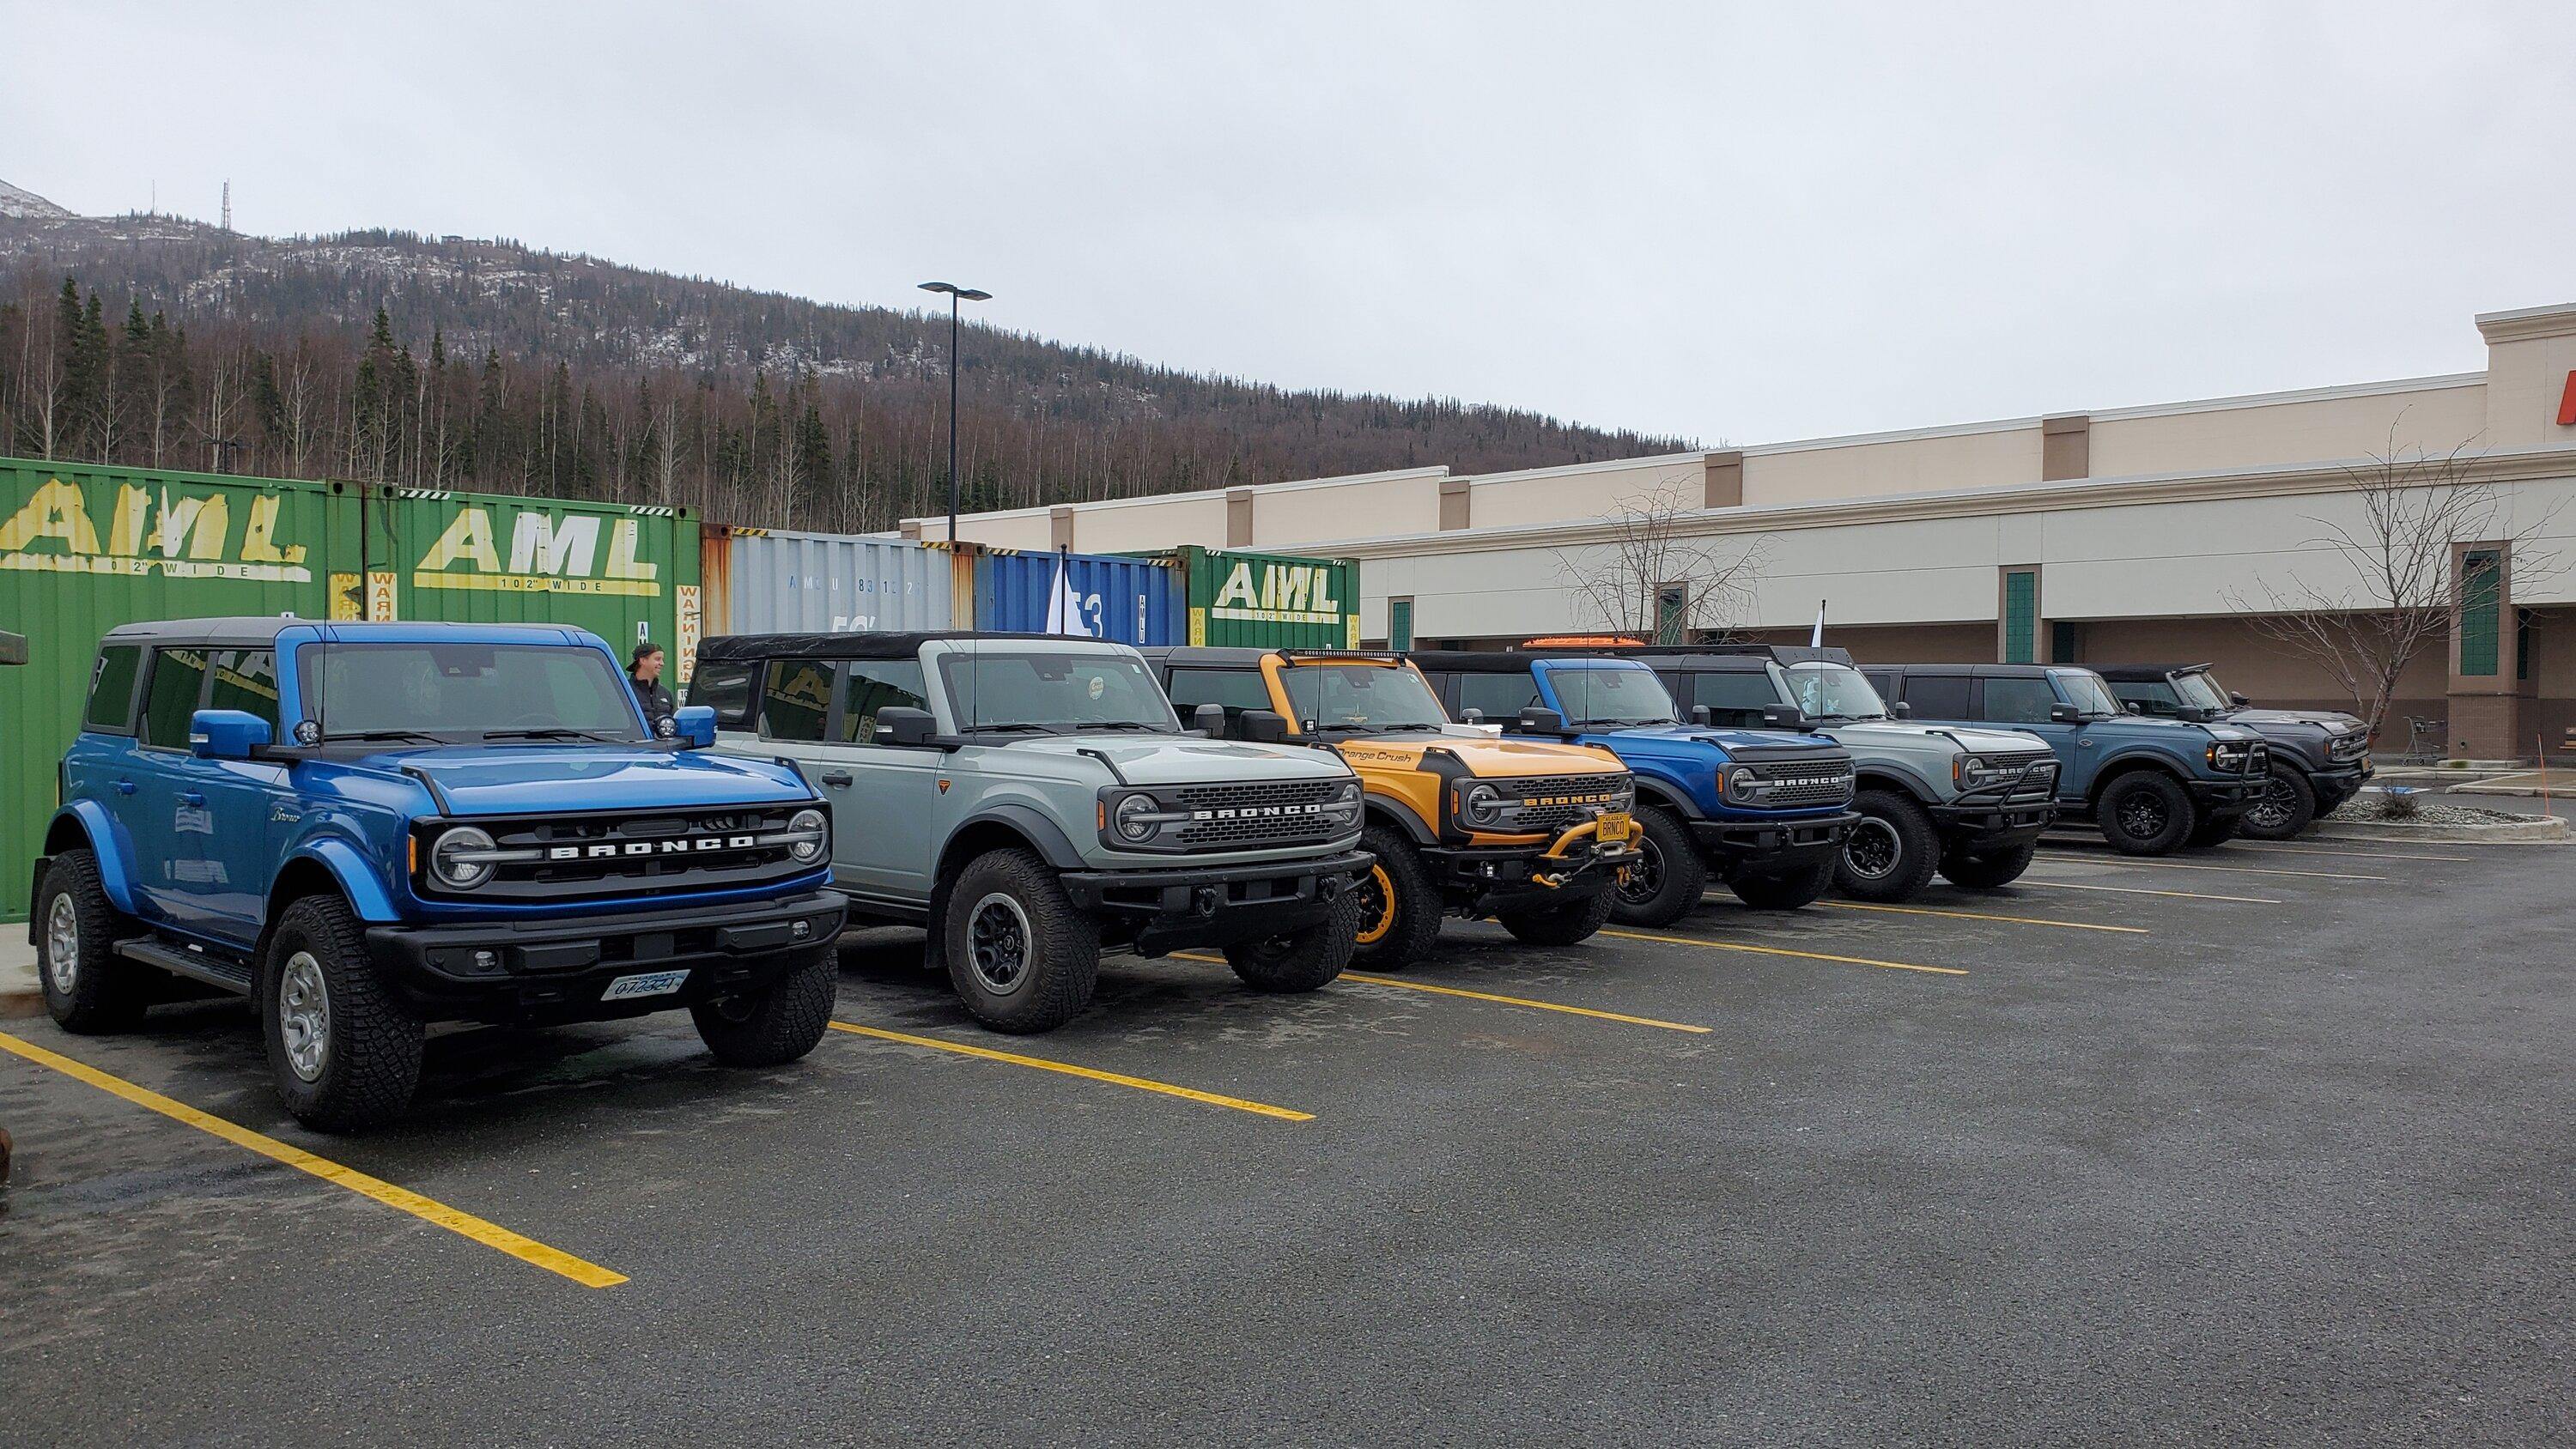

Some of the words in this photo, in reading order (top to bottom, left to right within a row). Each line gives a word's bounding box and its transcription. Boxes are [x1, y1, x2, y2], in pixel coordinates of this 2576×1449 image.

[0, 478, 307, 563] AML
[416, 508, 658, 580] AML
[166, 563, 248, 577] WIDE
[553, 580, 601, 591] WIDE
[1214, 562, 1339, 612] AML
[1376, 752, 1411, 762] Crush
[1774, 777, 1839, 786] BRONCO
[1523, 794, 1610, 806] BRONCO
[1194, 804, 1321, 820] BRONCO
[1602, 821, 1625, 836] BRNCO
[550, 836, 753, 858] BRONCO
